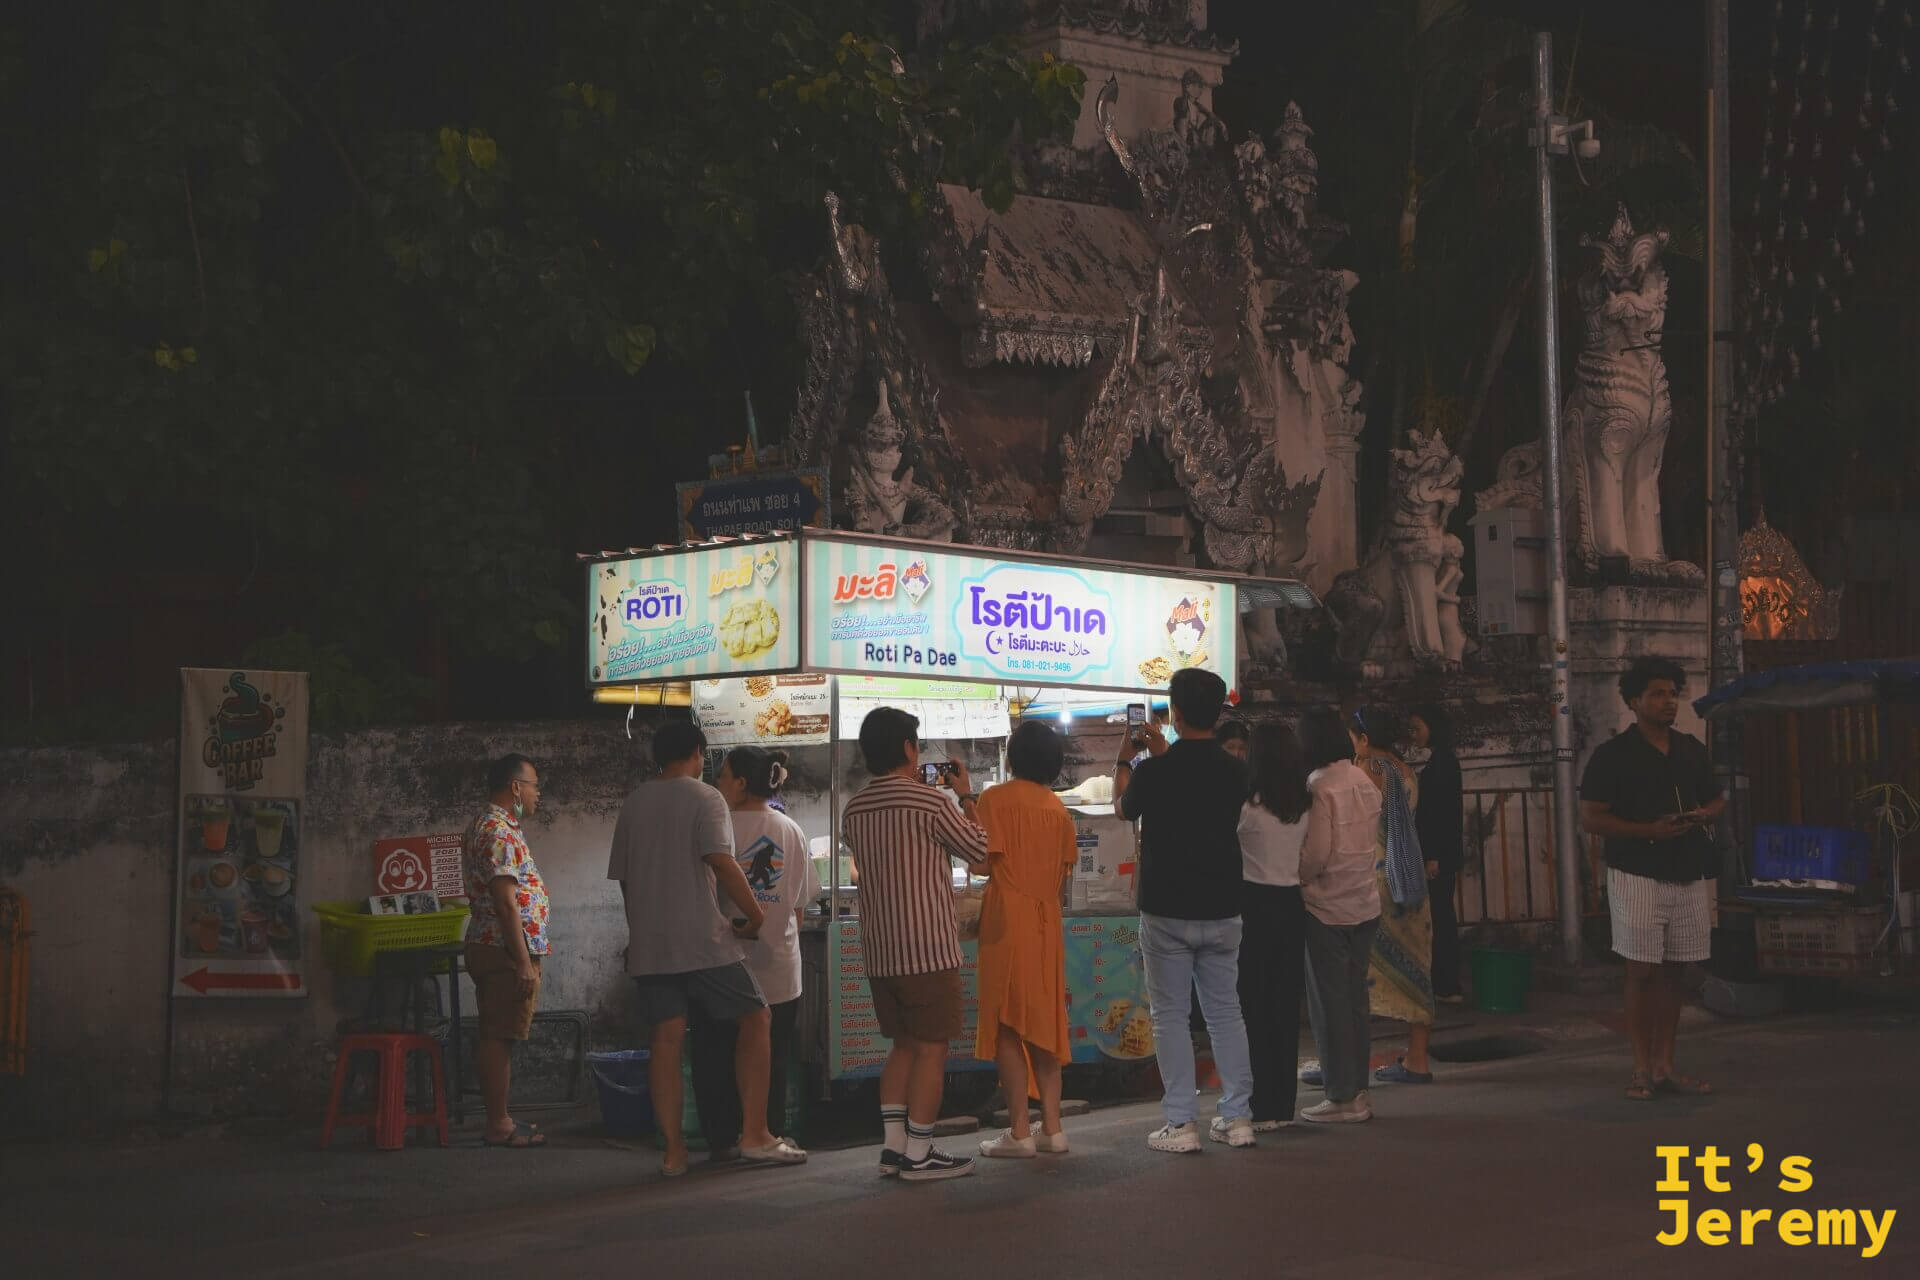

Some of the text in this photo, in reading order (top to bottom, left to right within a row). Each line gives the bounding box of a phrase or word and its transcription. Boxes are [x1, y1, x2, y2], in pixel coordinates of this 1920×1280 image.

[765, 494, 789, 511] ซอย
[706, 523, 742, 537] THAPAE
[745, 520, 773, 534] ROAD
[777, 518, 795, 530] SOI
[639, 584, 670, 596] โรตีป้าเด
[834, 564, 896, 601] มะลิ
[626, 594, 682, 621] ROTI
[970, 586, 1106, 636] โรตีป้าเด
[1008, 632, 1067, 653] โรตีมะตะบะ
[865, 643, 957, 666] Roti Pa Dae
[1007, 656, 1072, 673] โทร. 081-021-9496
[203, 732, 277, 768] COFFEE
[225, 758, 264, 785] BAR
[426, 834, 463, 845] MICHELIN
[436, 848, 458, 856] 2021
